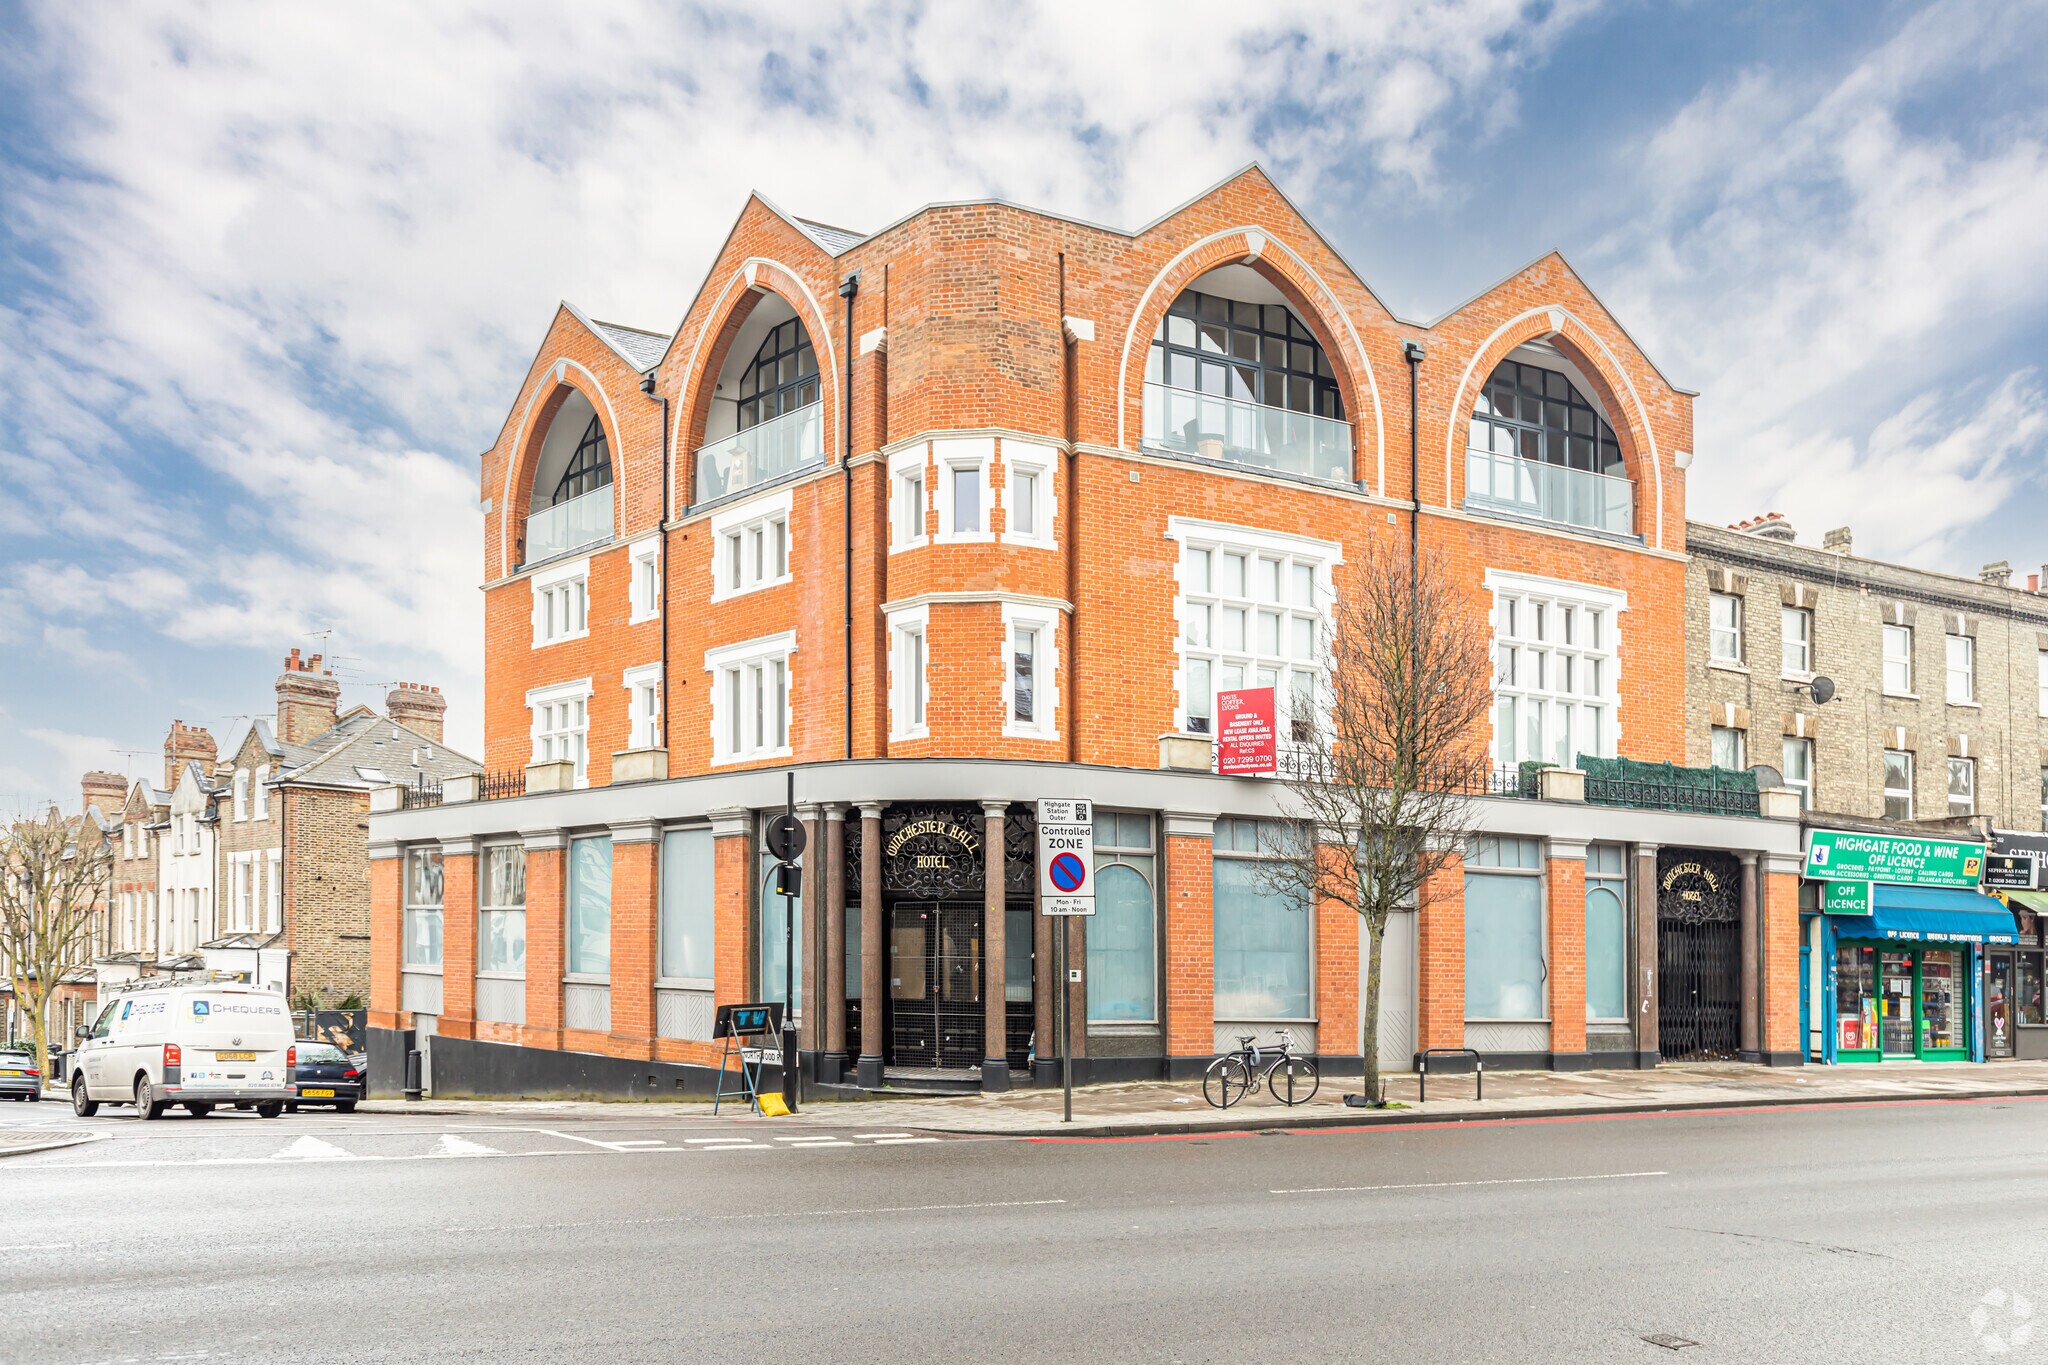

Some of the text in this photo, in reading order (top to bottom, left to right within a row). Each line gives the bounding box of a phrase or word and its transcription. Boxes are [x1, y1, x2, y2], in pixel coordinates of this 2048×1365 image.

[1042, 826, 1090, 836] Controlled
[886, 820, 980, 856] WINCHESTER HALL
[1049, 838, 1083, 849] ZONE
[1835, 837, 1959, 859] HIGHGATE FOOD & WINE
[917, 856, 949, 868] HOTEL
[1869, 854, 1925, 868] OFF LICENCE
[1663, 863, 1719, 892] WINCHESTER HALL
[1836, 870, 1869, 878] ACCESSORIES
[1682, 891, 1702, 901] HOTEL
[1838, 886, 1855, 896] OFF
[1828, 900, 1865, 909] LICENCE
[1927, 932, 1947, 940] WEEKLY
[1950, 934, 1982, 942] PROMOTIONS
[212, 1004, 281, 1015] CHEQUERS
